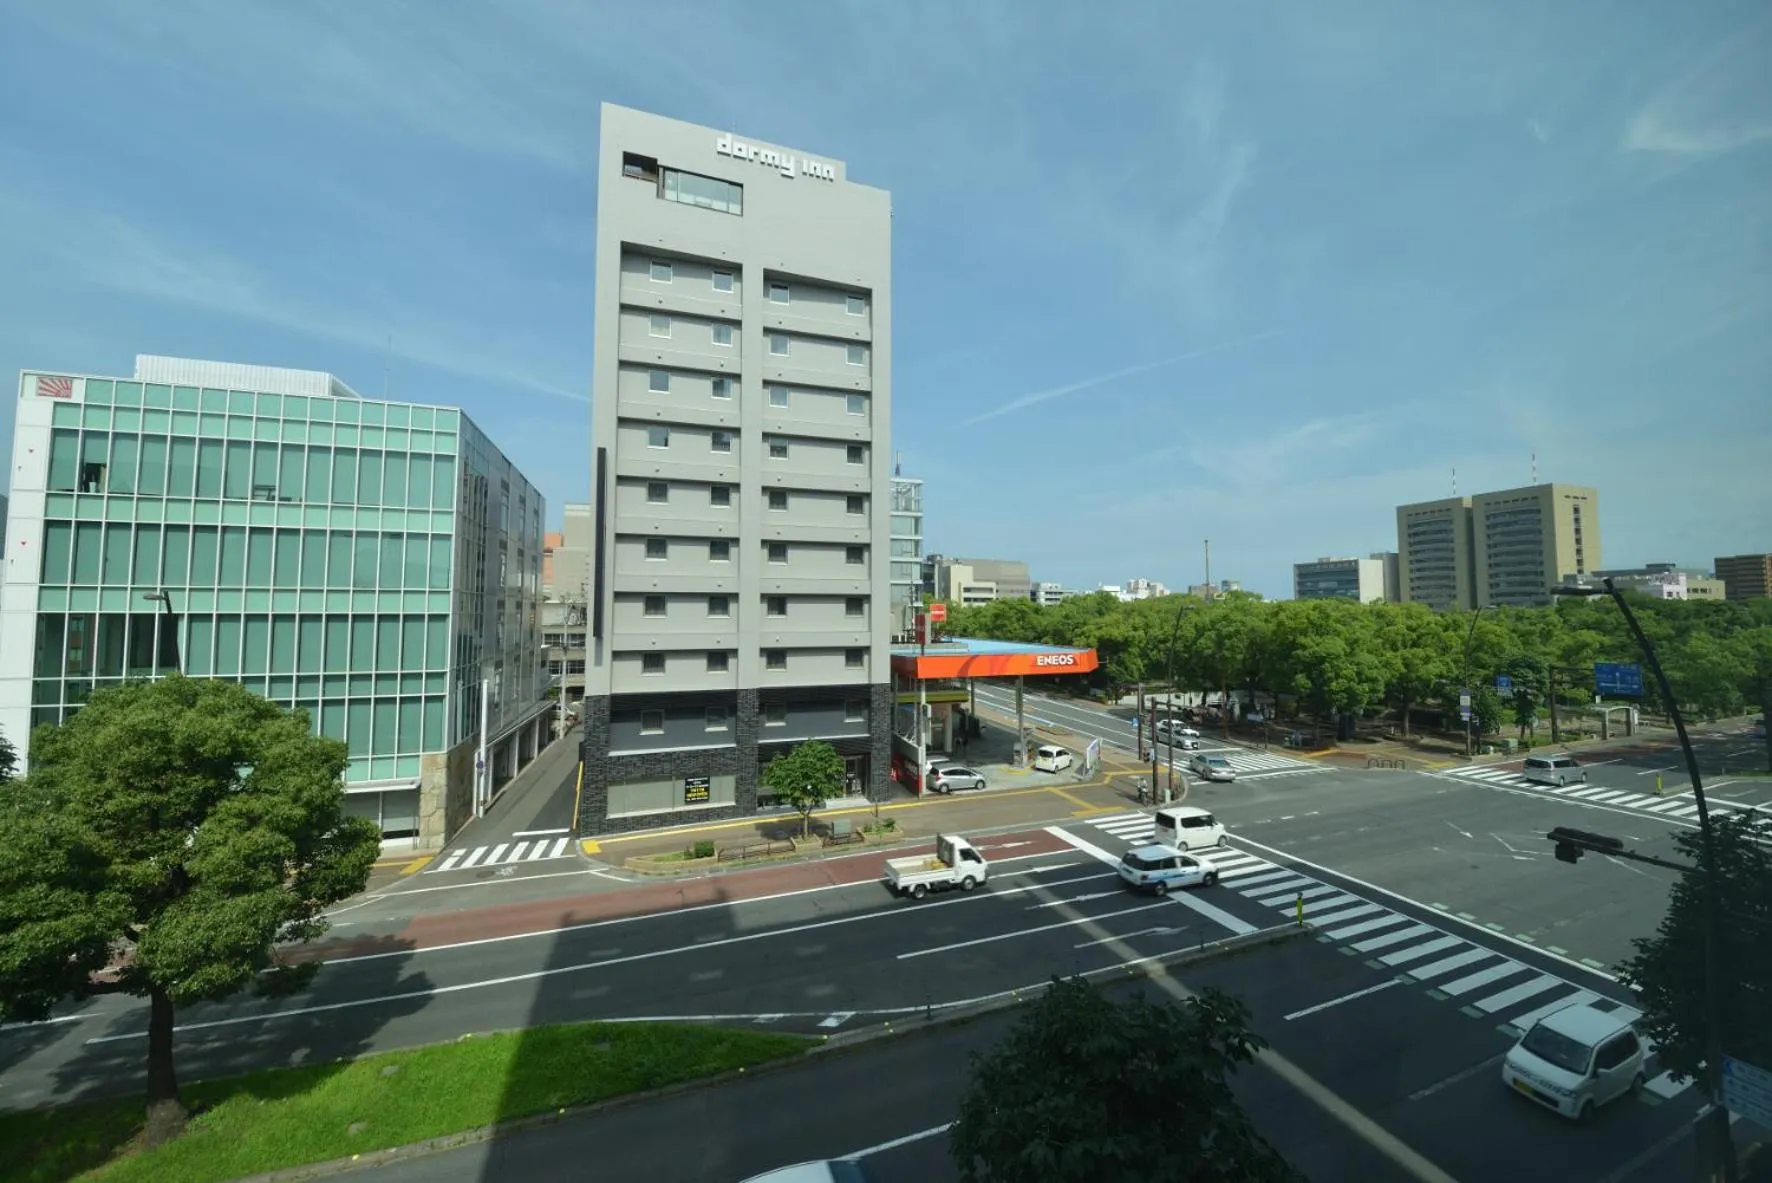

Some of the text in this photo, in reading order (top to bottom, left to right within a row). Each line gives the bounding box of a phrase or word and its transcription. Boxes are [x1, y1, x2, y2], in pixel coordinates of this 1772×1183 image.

[716, 133, 834, 181] dormy inn
[1036, 654, 1074, 666] ENEOS
